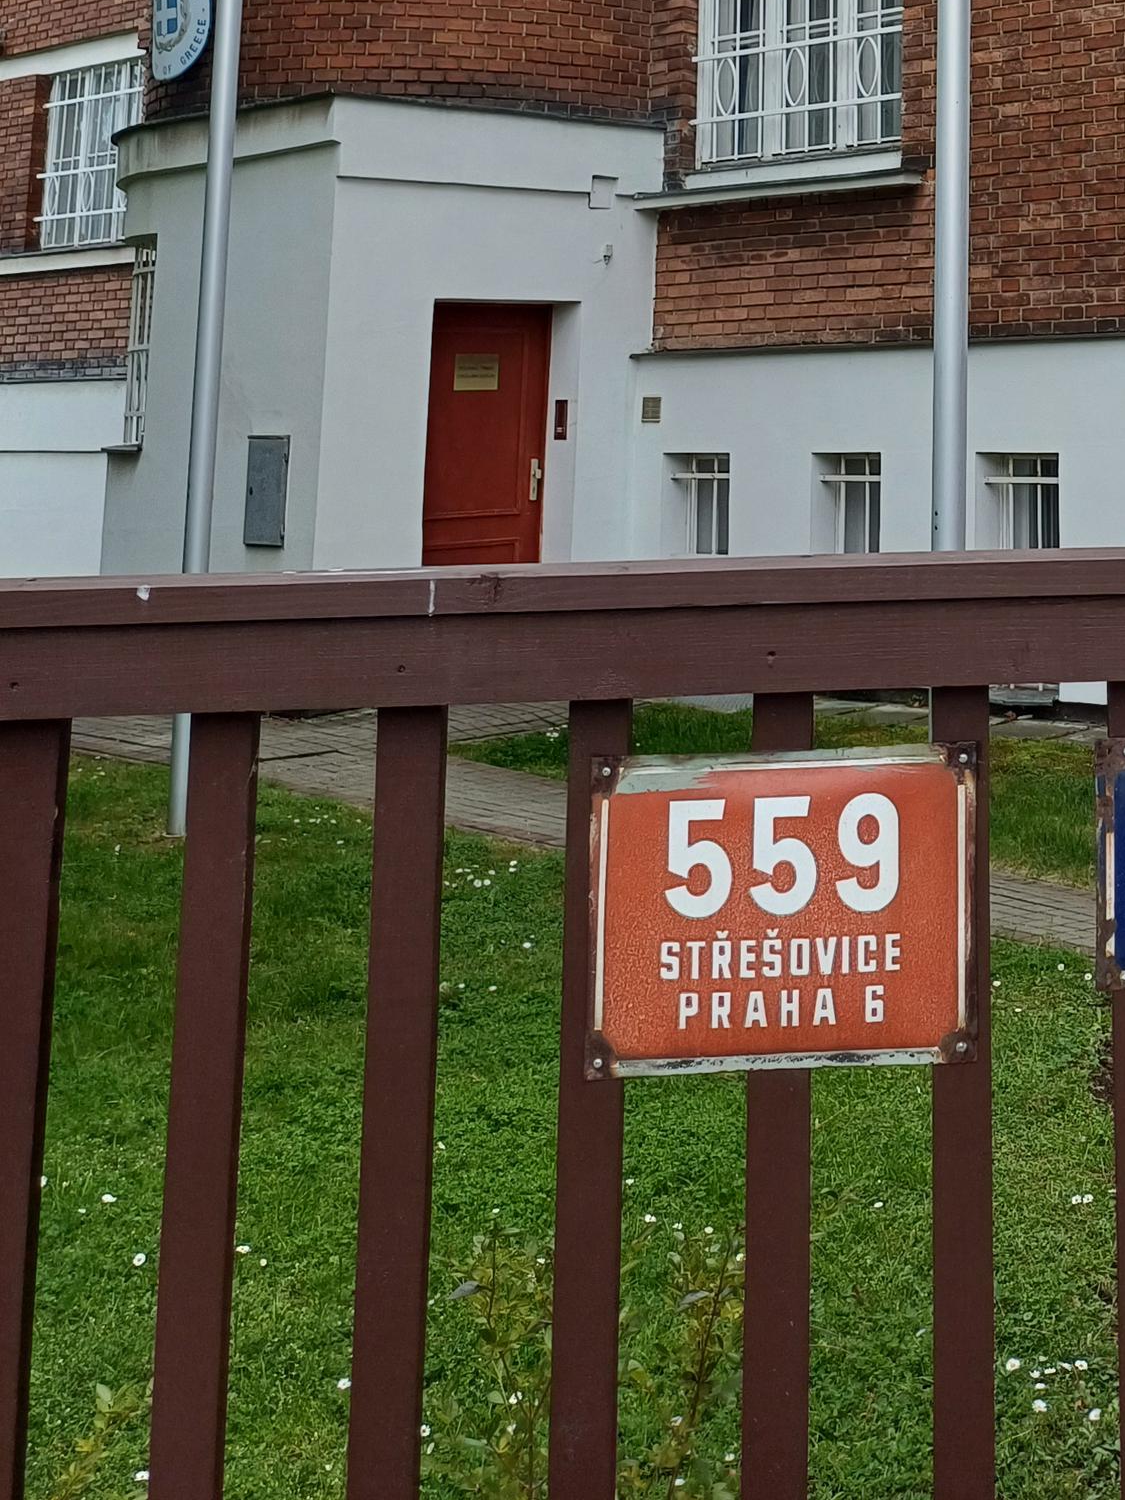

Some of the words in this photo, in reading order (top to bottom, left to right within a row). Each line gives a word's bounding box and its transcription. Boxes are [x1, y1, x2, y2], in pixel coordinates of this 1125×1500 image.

[180, 19, 207, 65] GREECE
[664, 793, 900, 918] 559
[659, 928, 901, 980] STŘEŠOVICE
[677, 987, 837, 1030] PRAHA
[864, 984, 885, 1023] 6
